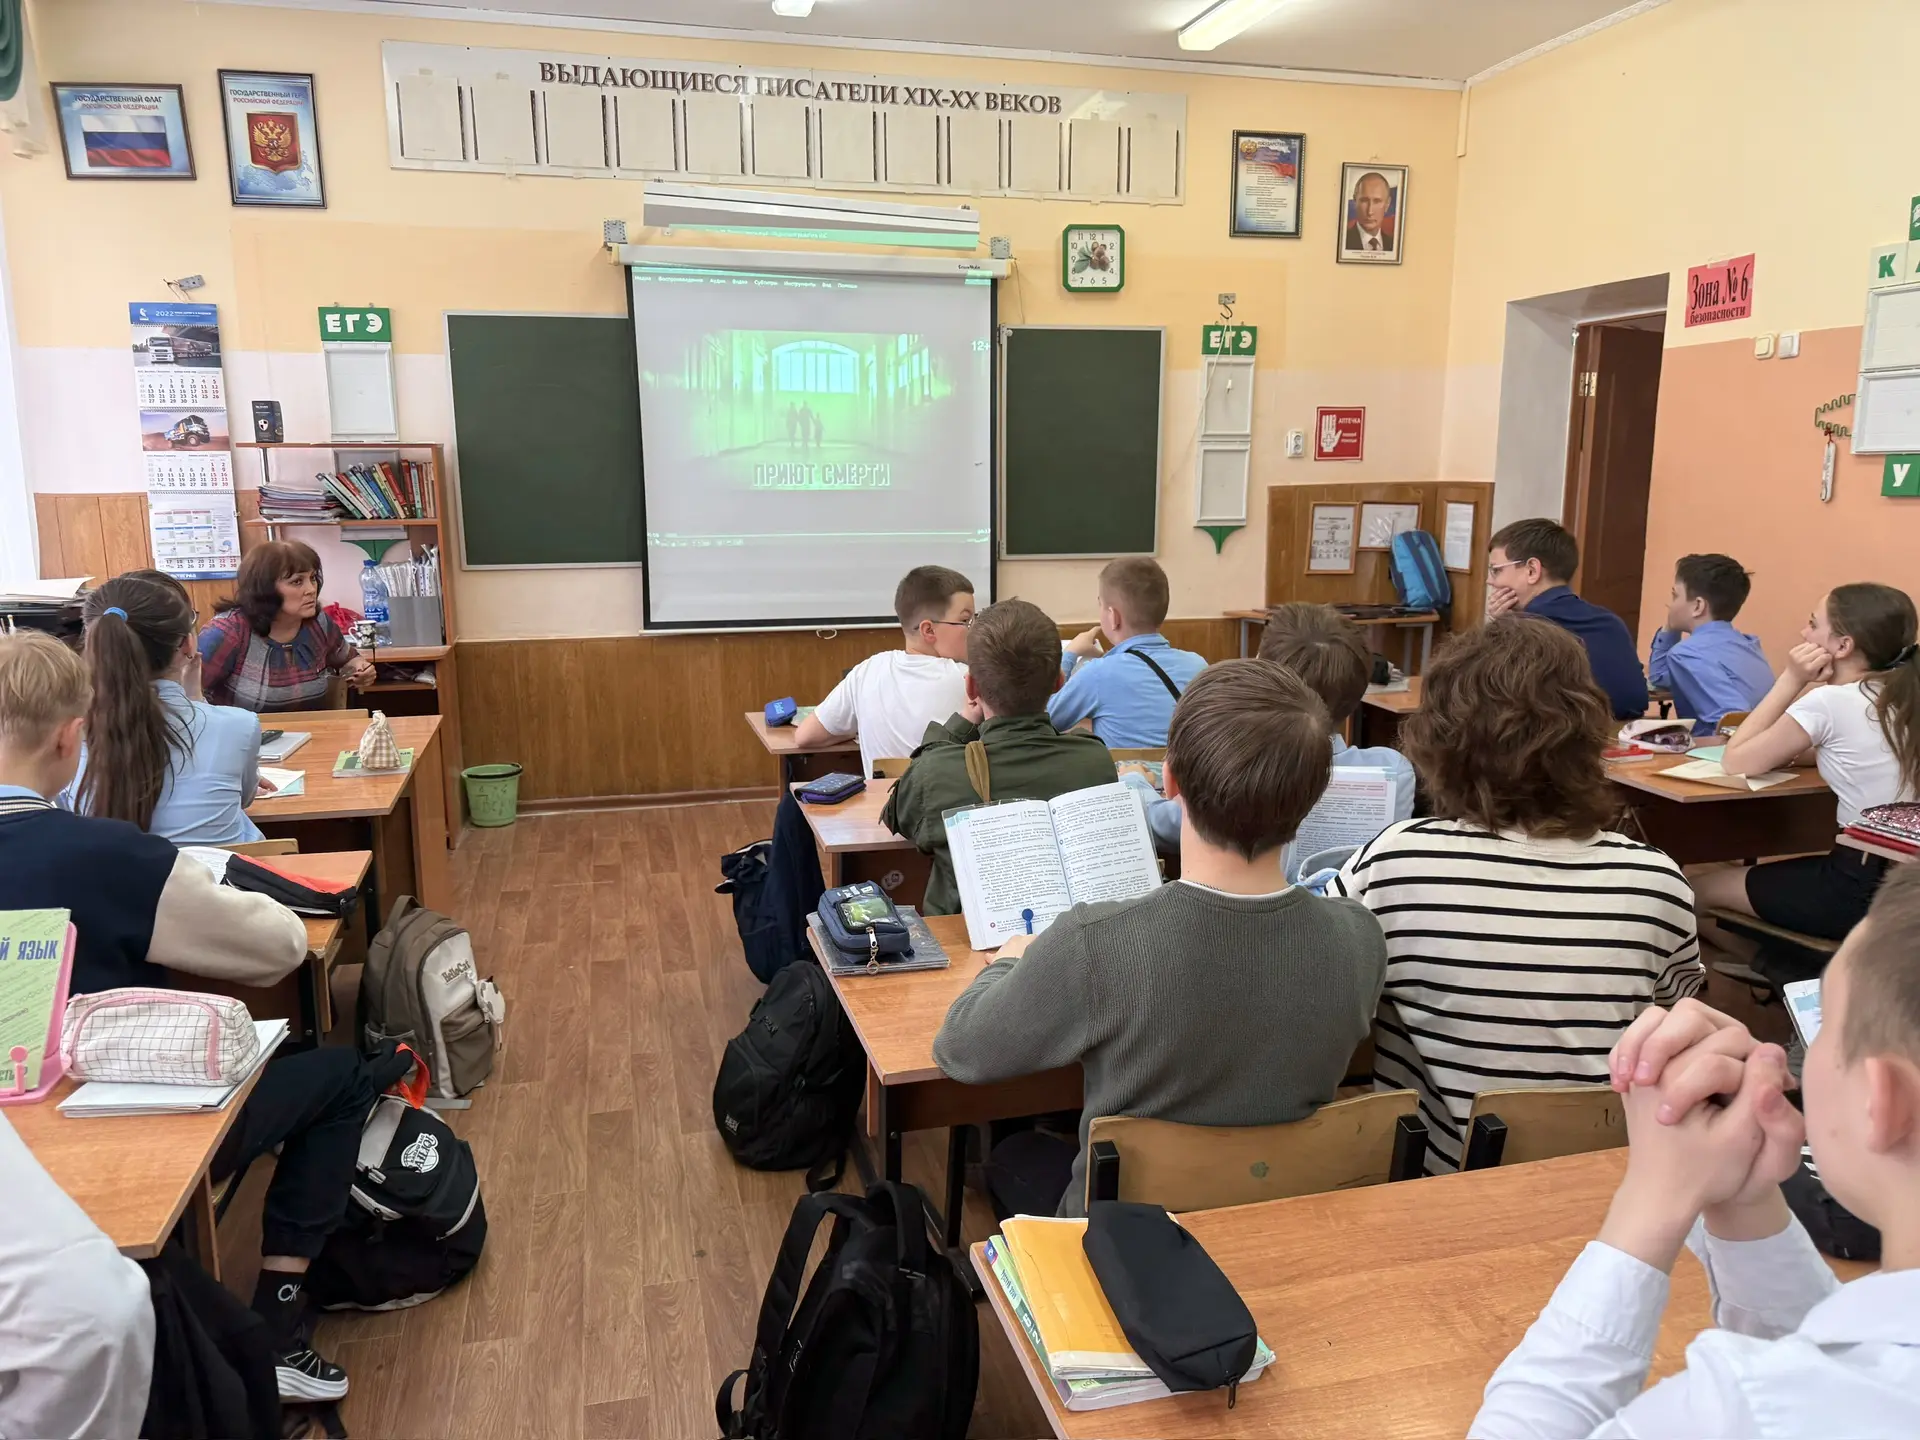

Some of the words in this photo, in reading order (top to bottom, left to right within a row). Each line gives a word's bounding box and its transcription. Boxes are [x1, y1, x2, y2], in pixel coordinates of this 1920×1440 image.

[539, 62, 749, 95] ВЫДАЮЩИЕСЯ
[755, 76, 899, 104] ПИСАТЕЛИ
[903, 86, 980, 110] XIX-XX
[985, 92, 1063, 115] ВЕКОВ
[1078, 232, 1084, 240] 11
[1090, 232, 1096, 240] 12
[1878, 252, 1896, 278] К
[1691, 274, 1720, 310] Зона
[1722, 266, 1738, 305] №
[1740, 263, 1750, 302] 6
[325, 313, 382, 333] ЕГЭ
[1690, 306, 1746, 325] безопасности
[971, 340, 990, 352] 12+
[1209, 330, 1253, 348] ЕГЭ
[754, 463, 816, 486] ПРИЮТ
[821, 463, 891, 486] СМЕРТИ
[1892, 463, 1912, 487] У
[17, 940, 59, 960] ЯЗЫК
[278, 1284, 301, 1301] CK
